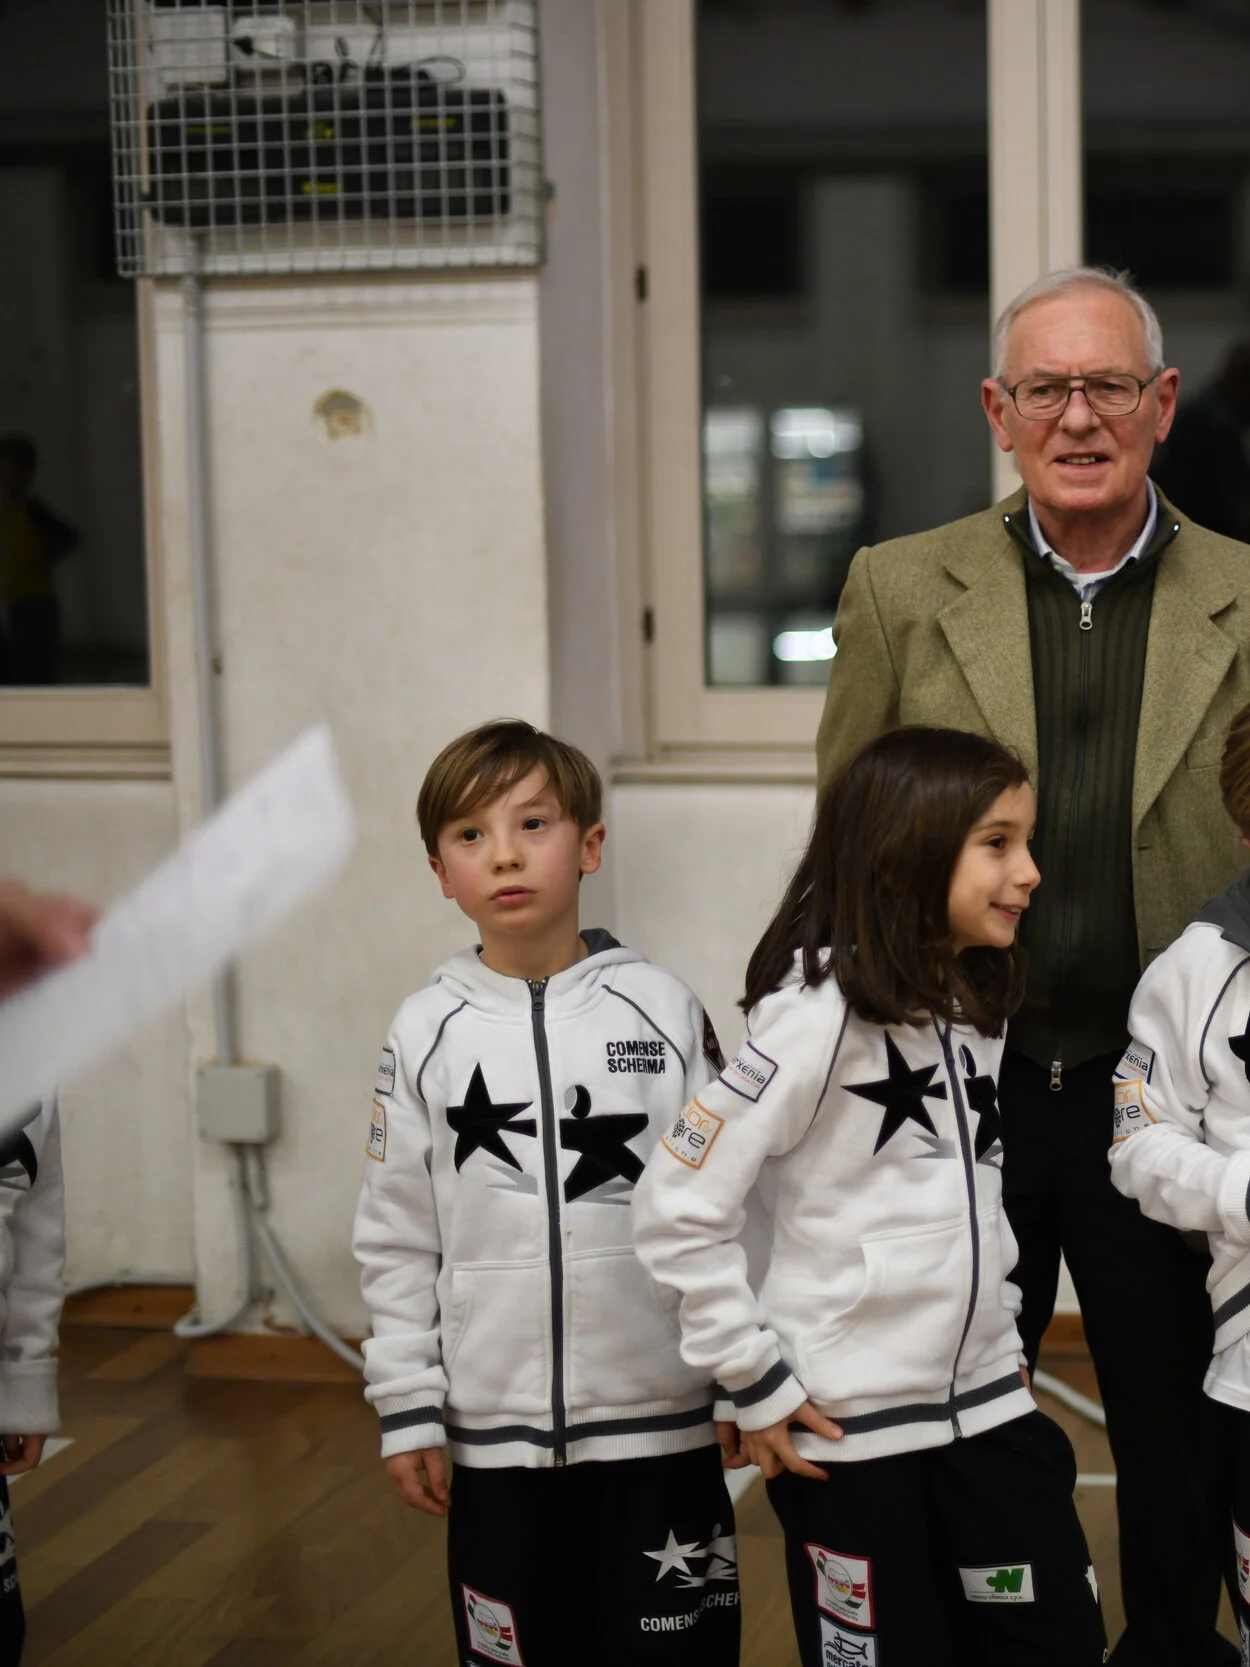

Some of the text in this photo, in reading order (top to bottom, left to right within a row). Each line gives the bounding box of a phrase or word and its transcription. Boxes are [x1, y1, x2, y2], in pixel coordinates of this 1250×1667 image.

[606, 1040, 666, 1057] COMENSE
[607, 1058, 666, 1075] SCHERMA
[640, 1609, 700, 1632] COMENS
